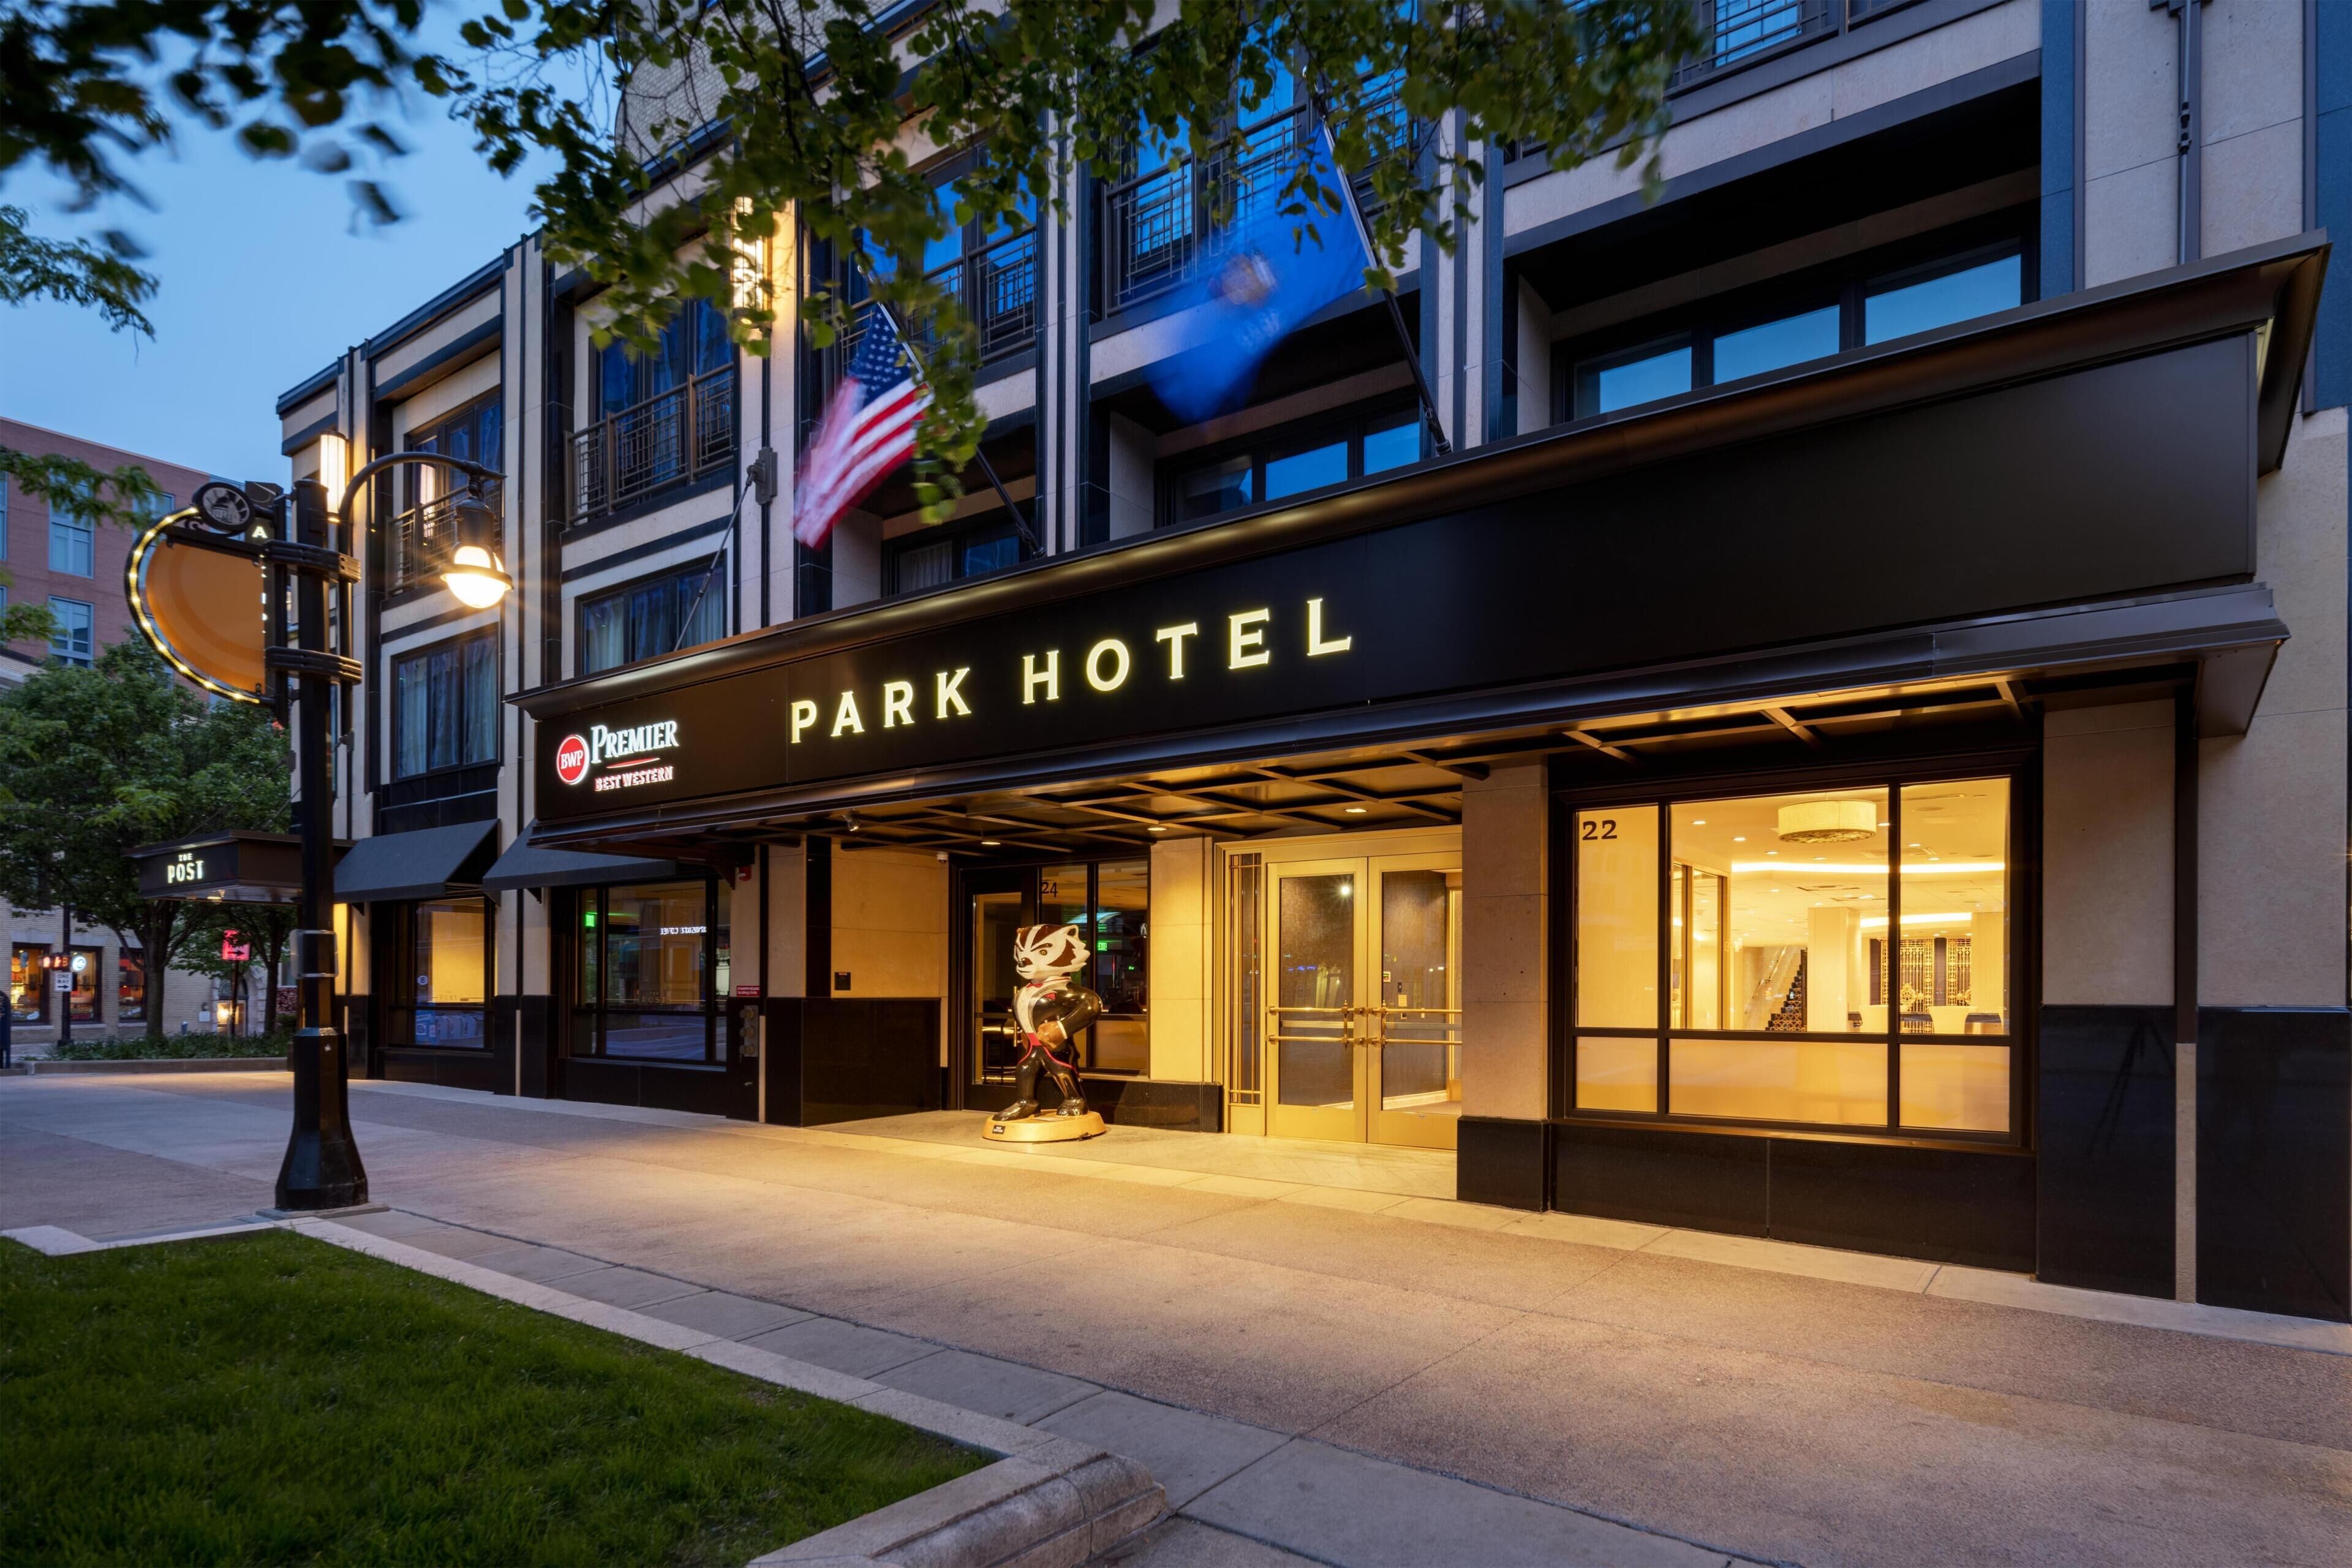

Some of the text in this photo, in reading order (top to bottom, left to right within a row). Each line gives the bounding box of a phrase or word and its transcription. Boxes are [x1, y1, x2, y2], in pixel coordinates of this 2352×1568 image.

[790, 598, 1352, 744] PARK HOTEL
[590, 720, 680, 764] PREMIER
[560, 750, 584, 769] BWP
[595, 766, 674, 792] BEST WESTERN
[1582, 820, 1618, 841] 22
[178, 853, 193, 862] THE
[167, 860, 205, 884] POST
[1040, 881, 1058, 898] 24
